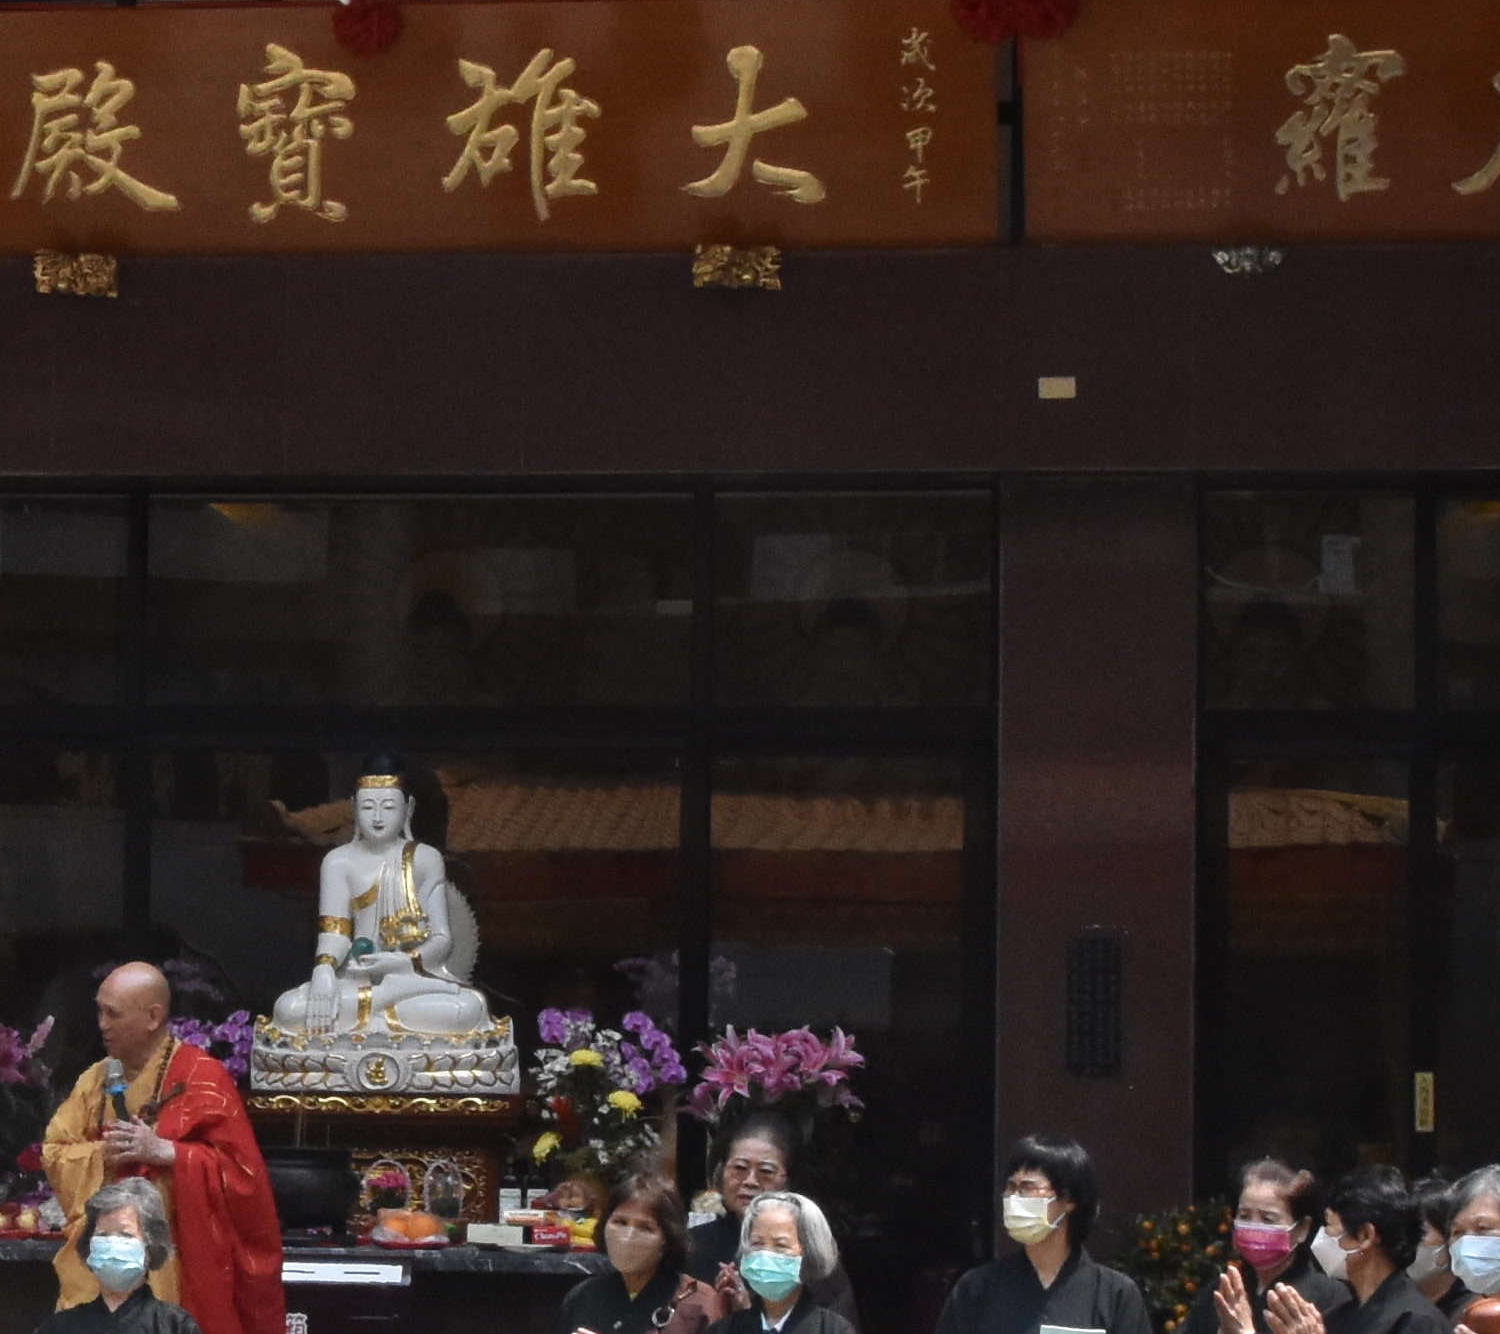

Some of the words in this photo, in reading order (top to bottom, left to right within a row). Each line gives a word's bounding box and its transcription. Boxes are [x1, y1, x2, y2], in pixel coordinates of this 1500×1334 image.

[10, 42, 826, 222] 大雄寶殿
[900, 26, 938, 204] 歲次甲午
